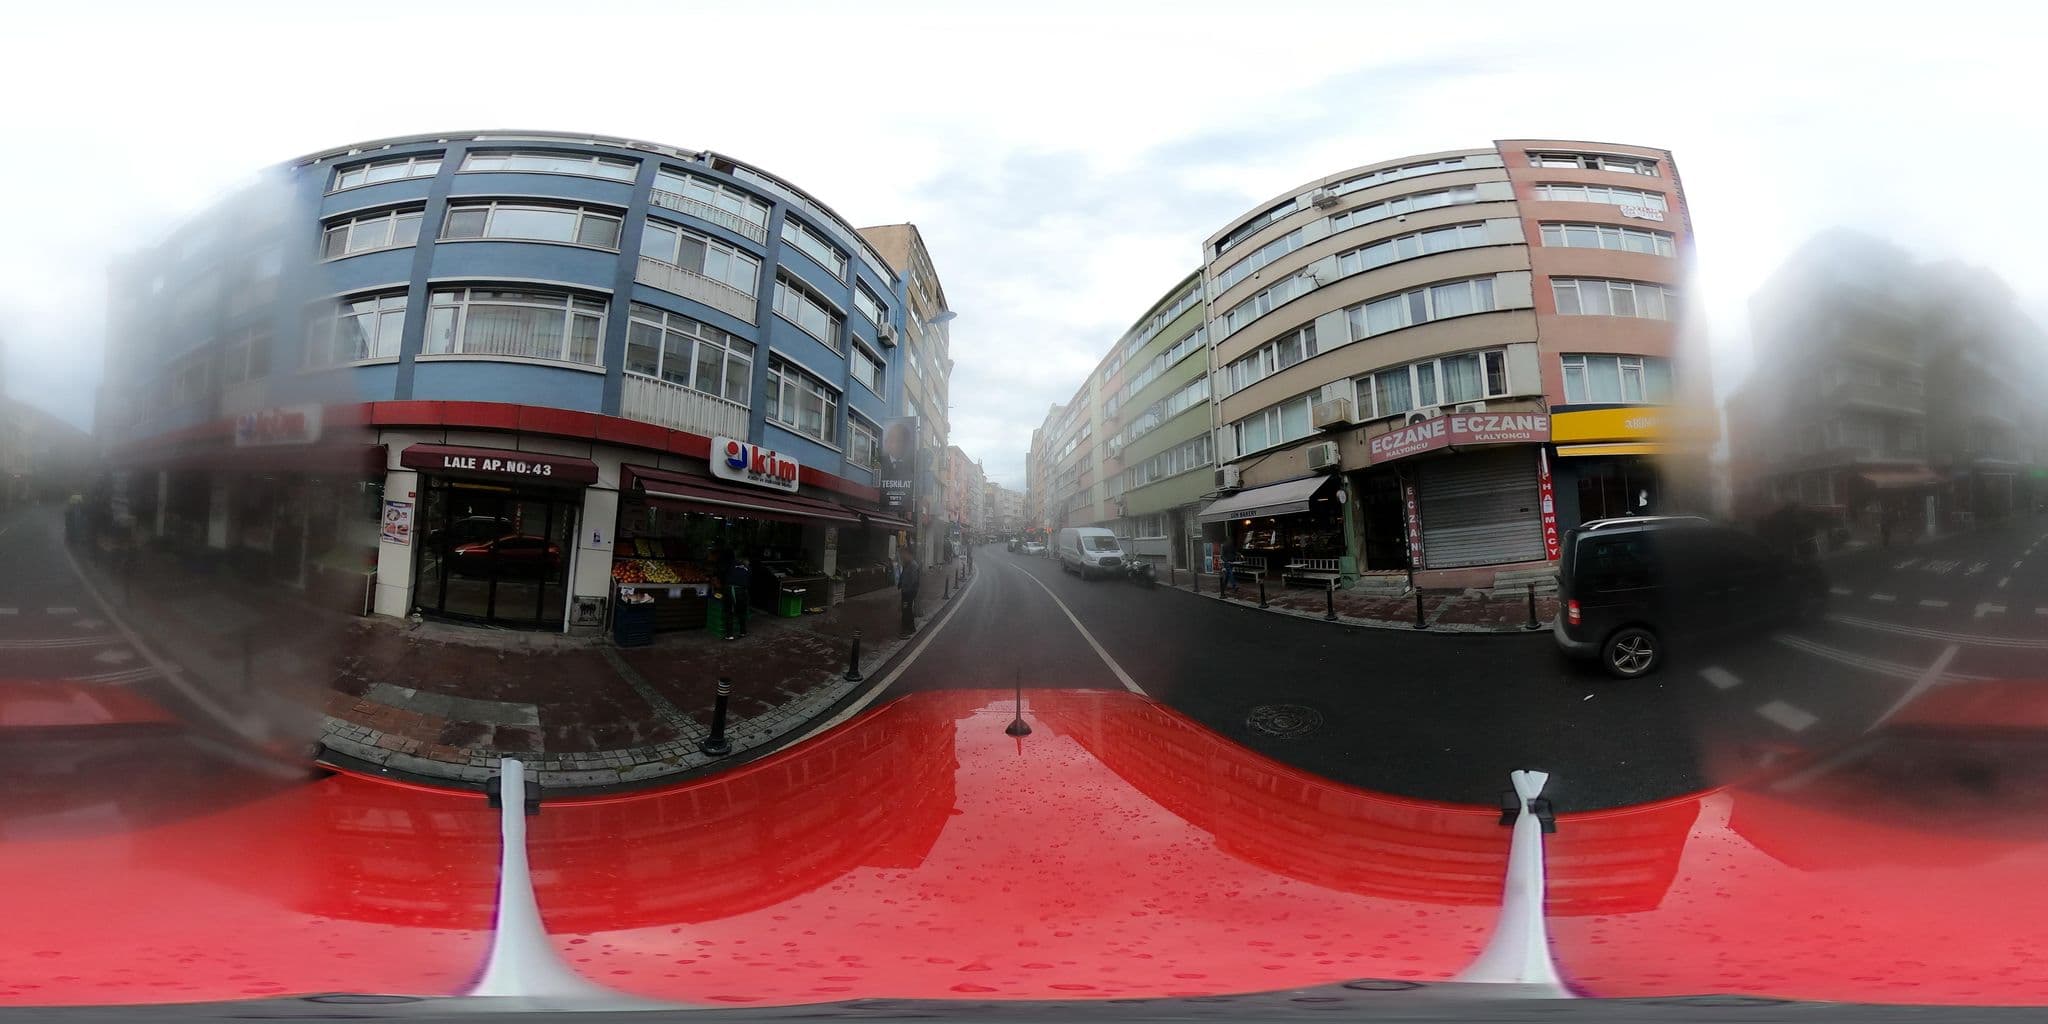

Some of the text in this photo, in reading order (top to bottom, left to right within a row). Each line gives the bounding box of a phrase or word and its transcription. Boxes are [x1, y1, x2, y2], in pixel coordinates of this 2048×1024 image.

[1452, 415, 1548, 433] ECZANE
[1372, 419, 1446, 454] ECZANE
[1475, 432, 1530, 441] KALYONCU
[1386, 442, 1428, 458] KALYONCU
[444, 456, 476, 469] LALE
[752, 446, 796, 480] kim
[1407, 486, 1420, 565] ECZANE
